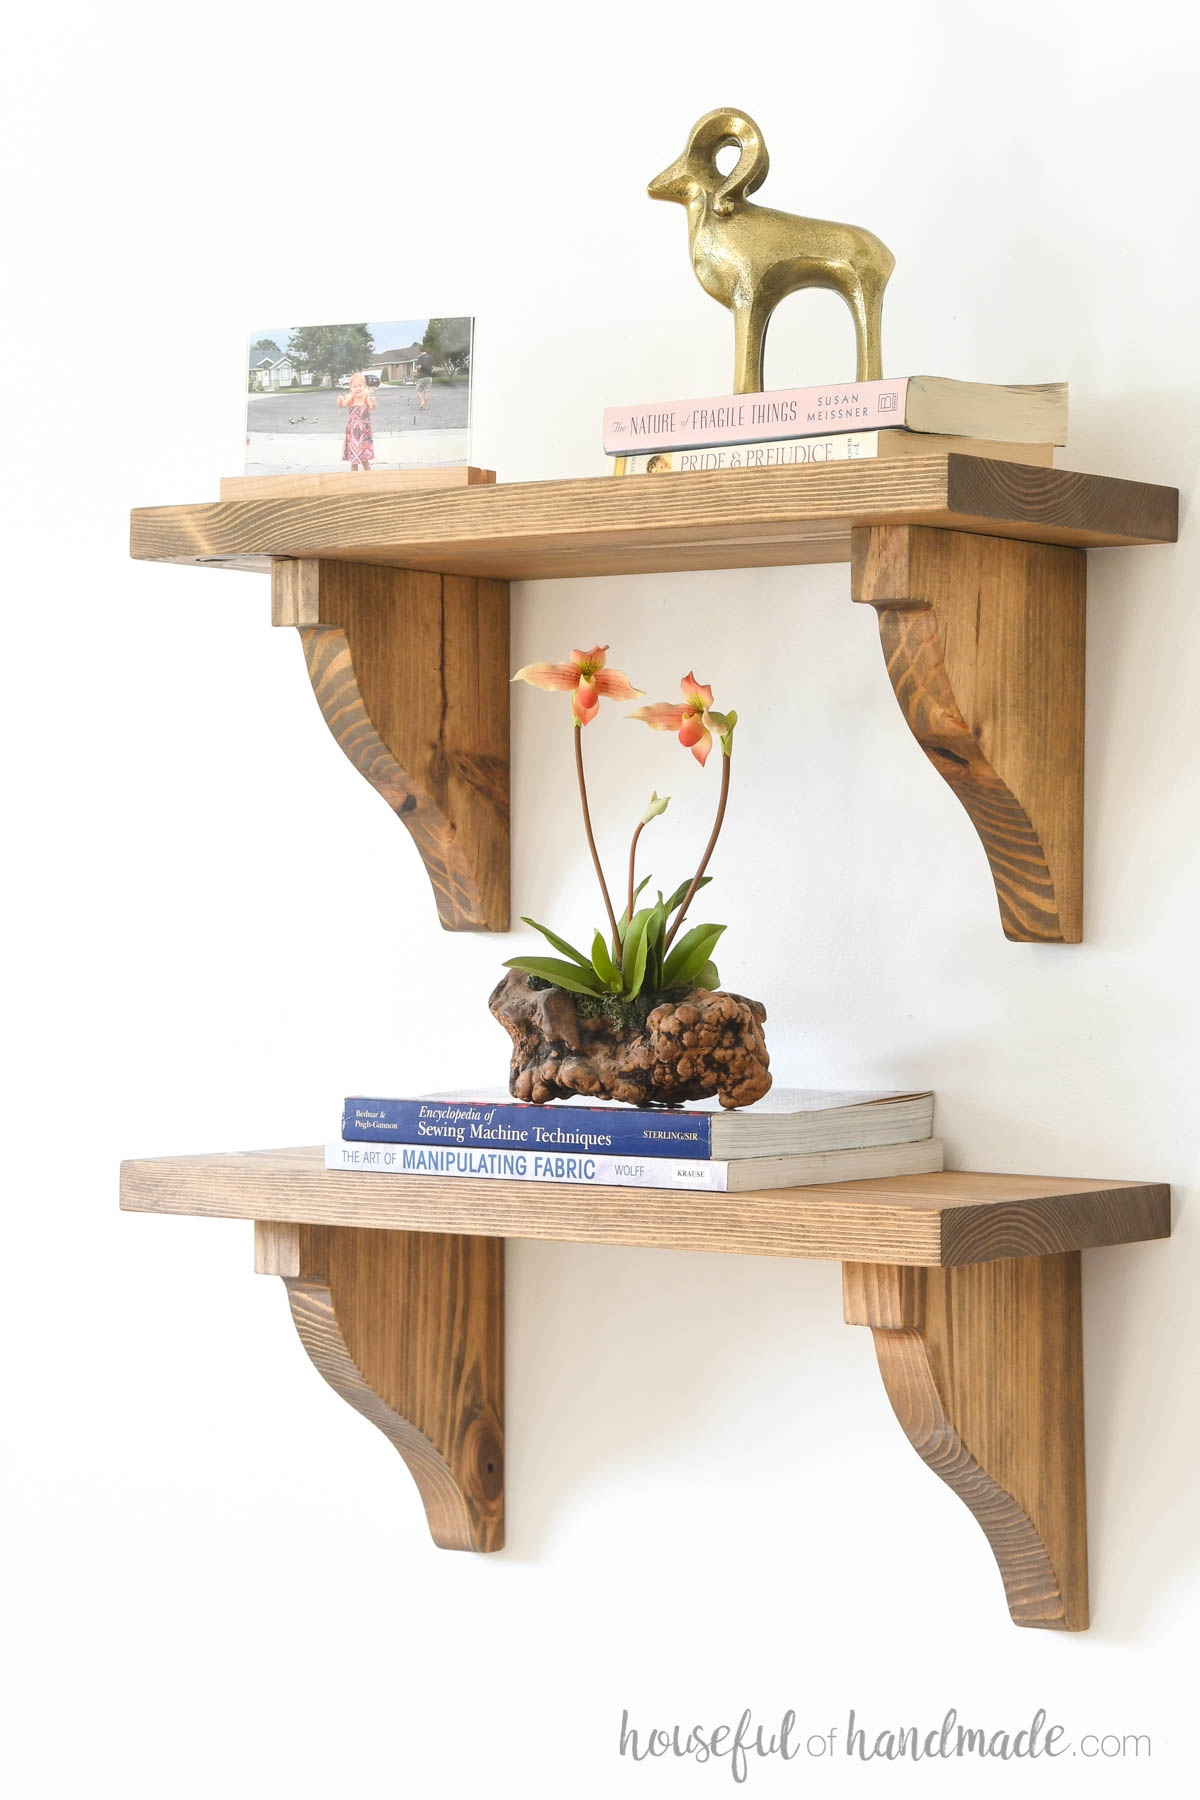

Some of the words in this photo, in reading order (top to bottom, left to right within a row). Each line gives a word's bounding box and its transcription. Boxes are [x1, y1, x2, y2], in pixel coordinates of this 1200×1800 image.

[817, 393, 859, 407] SUSAN
[630, 412, 677, 436] NATURE
[680, 414, 691, 431] of
[692, 405, 745, 430] FRAGILE
[751, 400, 797, 425] THINGS
[806, 407, 869, 422] MEISSNER
[680, 452, 726, 472] PRIDE
[746, 442, 834, 467] PREJUDICE
[355, 1109, 379, 1119] Bednar
[419, 1105, 481, 1124] Encyclopedia
[484, 1108, 496, 1125] of
[417, 1120, 466, 1143] Sewing
[469, 1123, 529, 1142] Machine
[532, 1126, 612, 1150] Techniques
[642, 1130, 699, 1141] STERLING/SIR
[341, 1149, 361, 1164] THE
[363, 1151, 382, 1165] ART
[383, 1152, 397, 1165] OF
[402, 1149, 527, 1177] MANIPULATING
[534, 1156, 596, 1180] FABRIC
[614, 1164, 645, 1177] WOLFF
[677, 1169, 705, 1178] KRAUSE
